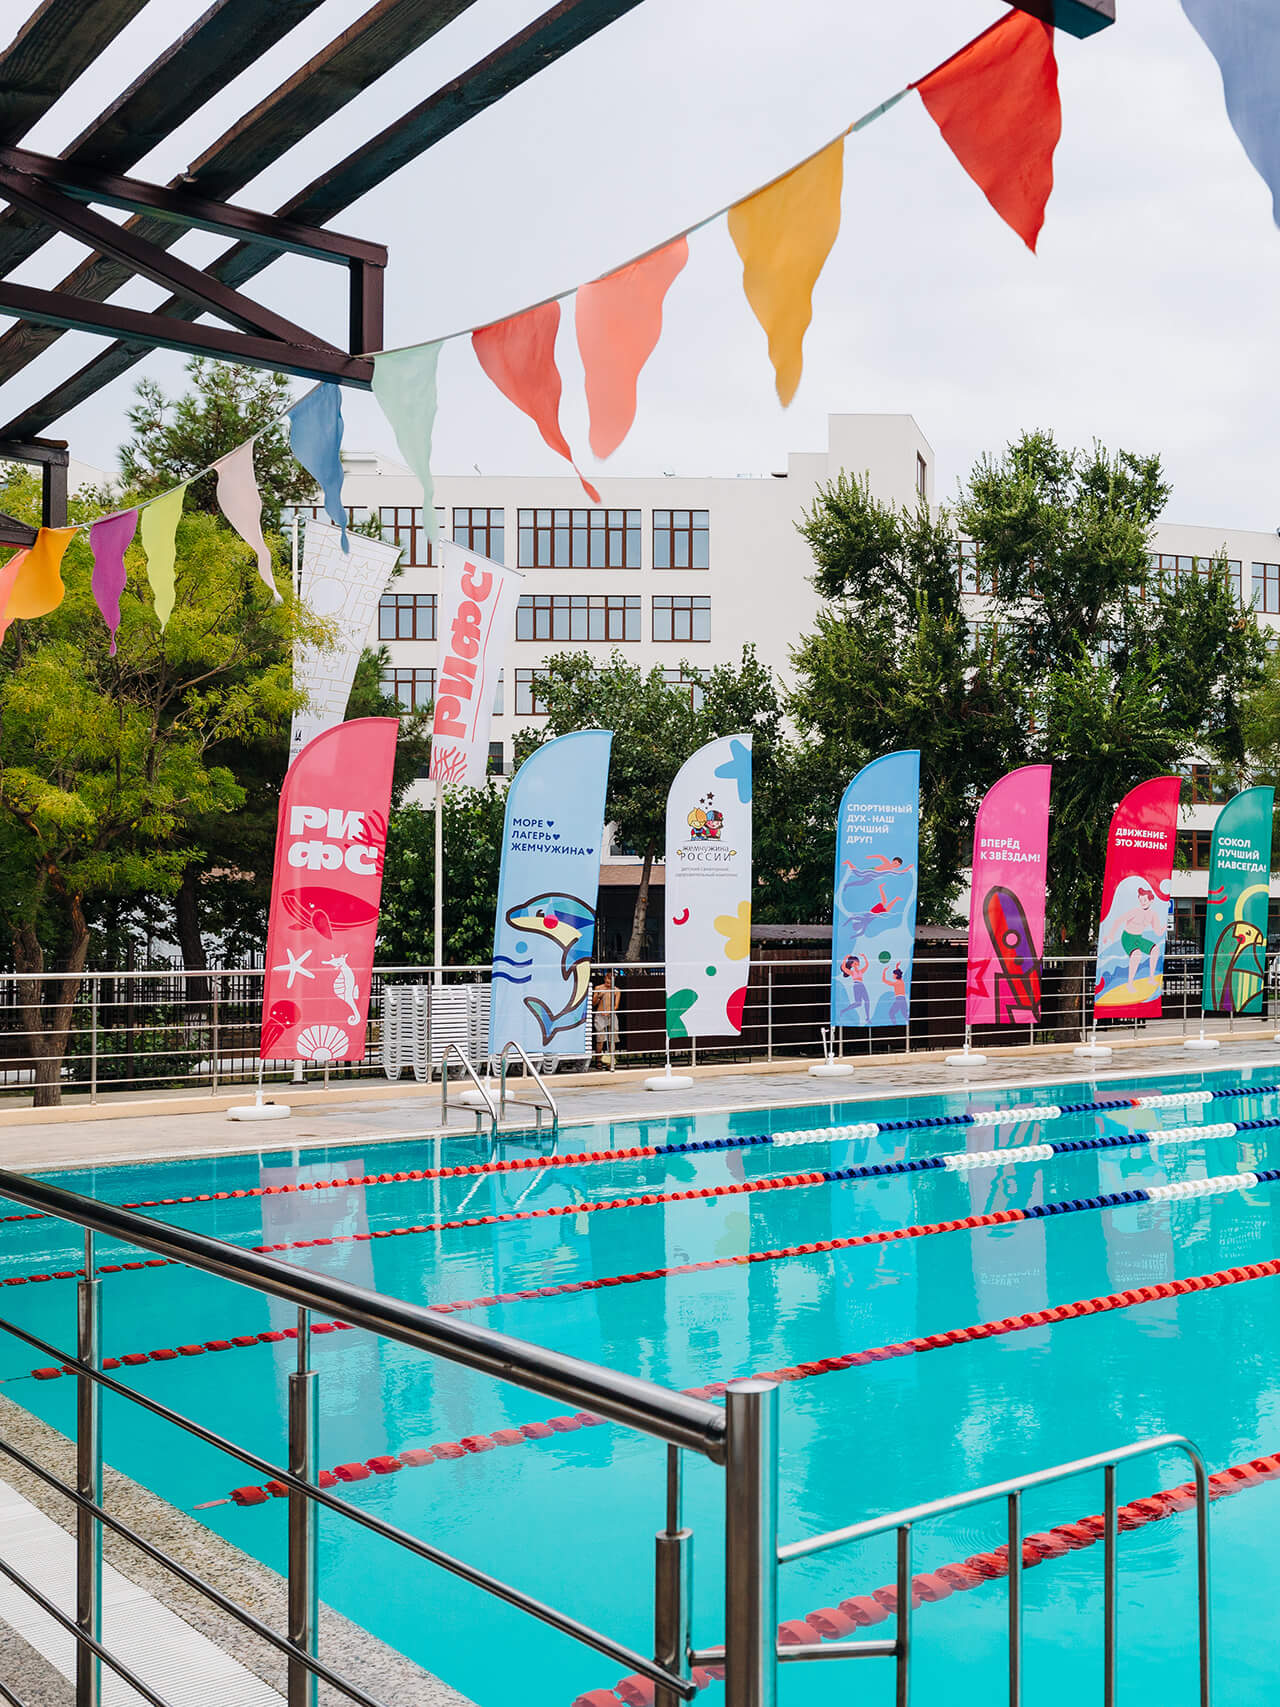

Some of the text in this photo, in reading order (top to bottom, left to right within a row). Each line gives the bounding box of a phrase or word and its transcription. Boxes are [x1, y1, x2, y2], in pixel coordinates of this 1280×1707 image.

[433, 561, 493, 739] РИФС
[847, 803, 913, 813] СПОРТИВНЫЙ
[289, 805, 365, 841] РИ
[512, 818, 544, 828] МОРЕ
[847, 814, 866, 823] ДУХ
[872, 815, 895, 824] НАШ
[846, 824, 889, 834] ЛУЧШИЙ
[1115, 827, 1168, 840] ДВИЖЕНИЕ-
[511, 830, 552, 841] ЛАГЕРЬ
[846, 835, 873, 845] ДРУГ!
[980, 837, 1021, 850] ВПЕРЁД
[1115, 838, 1168, 850] ЭТО ЖИЗНЬ!
[1217, 837, 1251, 848] СОКОЛ
[510, 842, 586, 856] ЖЕМЧУЖИНА
[1217, 848, 1260, 861] ЛУЧШИЙ
[287, 839, 379, 876] ФС
[680, 852, 732, 861] РОССИИ
[980, 849, 1041, 863] К ЗВЁЗДАМ!
[1217, 859, 1267, 873] НАВСЕГДА!
